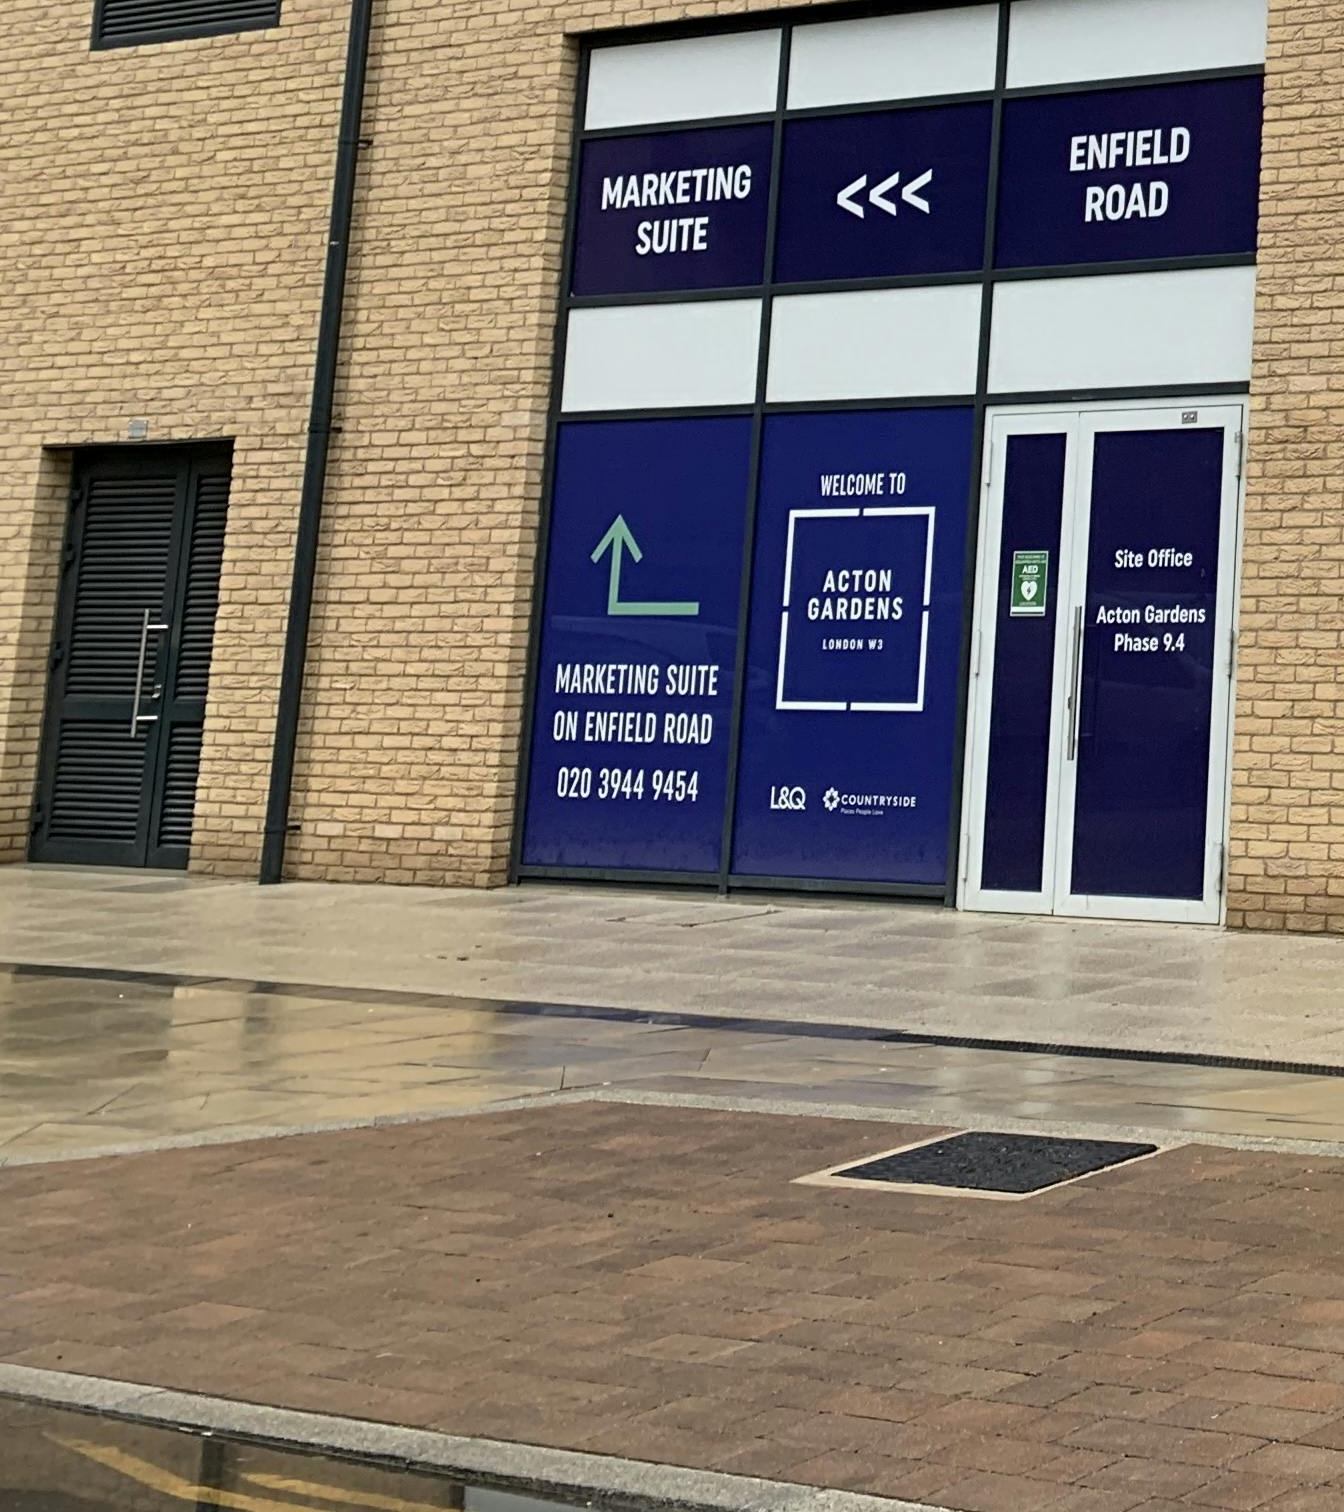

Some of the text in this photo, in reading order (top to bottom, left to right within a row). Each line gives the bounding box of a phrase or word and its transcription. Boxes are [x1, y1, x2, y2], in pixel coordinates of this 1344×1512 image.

[1070, 127, 1190, 171] ENFIELD
[602, 165, 751, 210] MARKETING
[1085, 181, 1168, 222] ROAD
[636, 217, 708, 254] SUITE
[821, 473, 905, 496] WELCOME TO
[1022, 565, 1038, 574] AED
[1115, 548, 1192, 568] Site Office
[823, 570, 891, 592] ACTON
[808, 597, 902, 620] GARDENS
[1096, 605, 1205, 623] Acton Gardens
[823, 639, 883, 650] LONDON W3
[1115, 633, 1184, 651] Phase 9.4
[556, 664, 719, 695] MARKETING SUITE
[553, 711, 712, 744] ON ENFIELD ROAD
[557, 767, 698, 801] 020 3944 9454
[771, 786, 916, 809] L&Q COUNTRYSIDE
